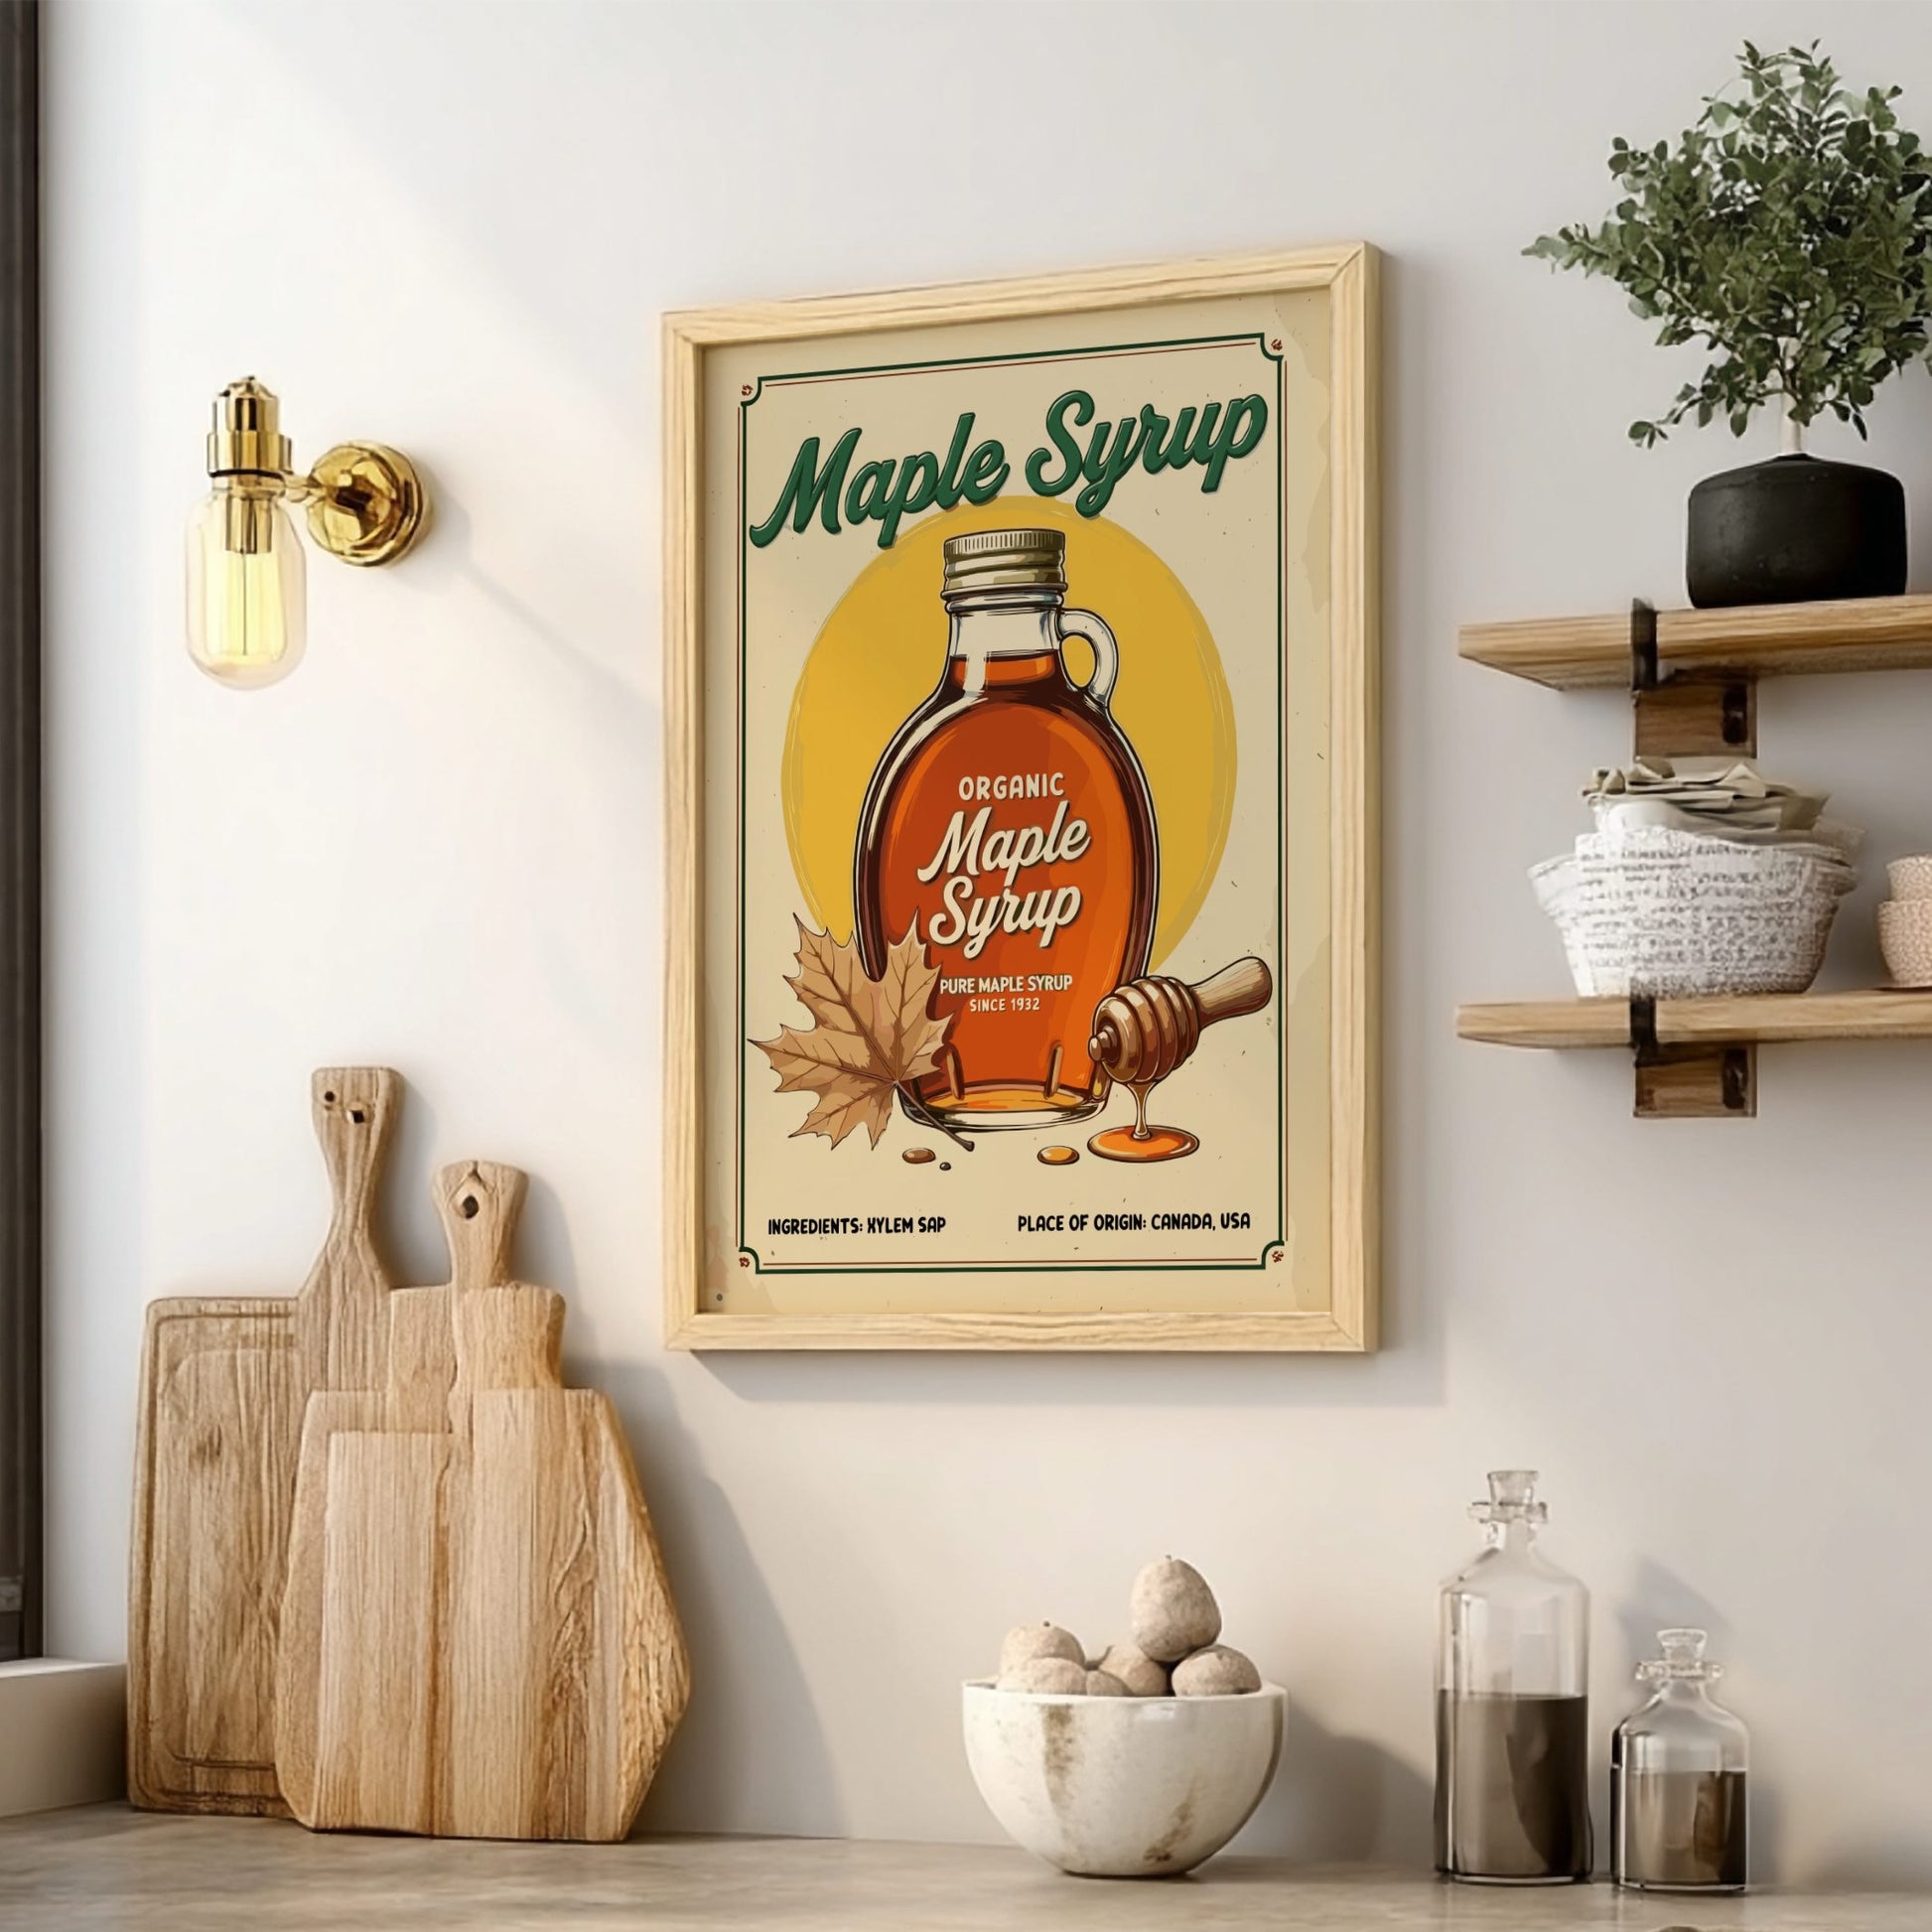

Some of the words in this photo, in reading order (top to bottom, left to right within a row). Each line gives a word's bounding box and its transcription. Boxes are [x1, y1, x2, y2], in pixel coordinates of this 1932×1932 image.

[750, 412, 1011, 548] Maple
[1025, 390, 1269, 518] Syrup
[958, 772, 1065, 801] ORGANIC
[916, 800, 1091, 887] Maple
[928, 875, 1082, 959] Syrup
[939, 978, 976, 995] PURE
[978, 976, 1025, 994] MAPLE
[1027, 974, 1073, 992] SYRUP
[969, 998, 1007, 1012] SINCE
[1011, 997, 1040, 1011] 1932
[767, 1217, 864, 1235] INGREDIENTS:
[917, 1216, 947, 1233] SAP
[1018, 1214, 1065, 1232] PLACE
[1068, 1214, 1090, 1232] OF
[1093, 1213, 1148, 1231] ORIGIN:
[1151, 1212, 1217, 1231] CANADA,
[1220, 1211, 1251, 1229] USA
